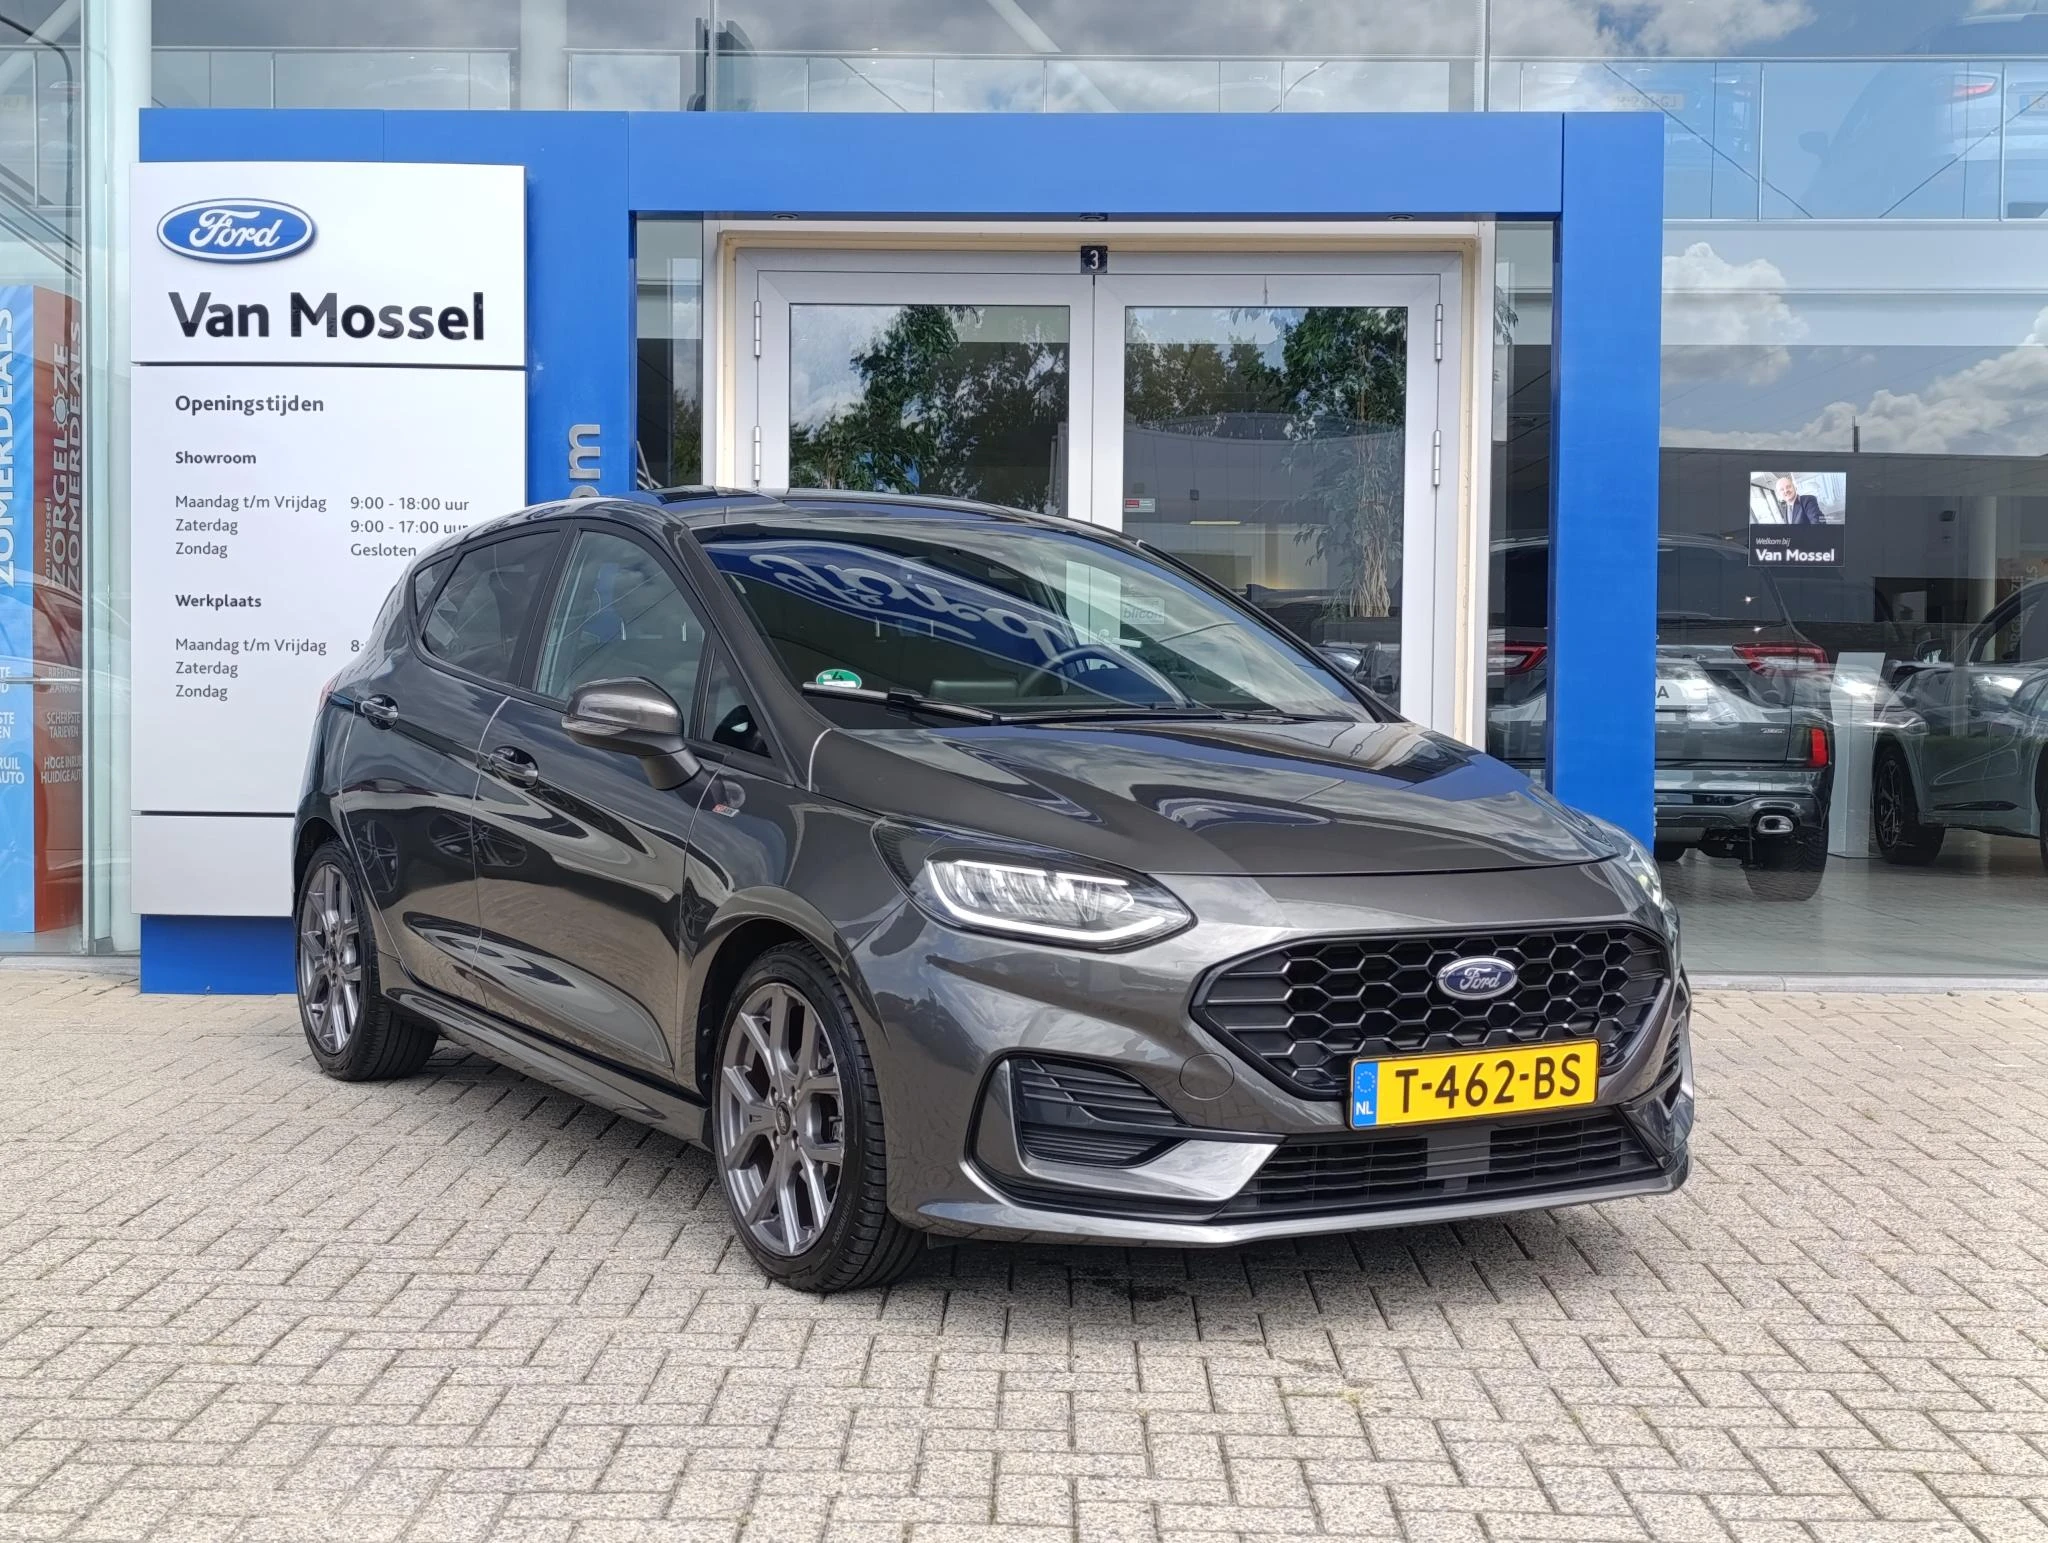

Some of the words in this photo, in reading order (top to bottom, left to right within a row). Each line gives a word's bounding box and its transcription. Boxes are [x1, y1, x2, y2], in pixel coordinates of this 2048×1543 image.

[189, 208, 282, 248] Ford
[1090, 250, 1099, 269] 3
[168, 292, 269, 338] Van
[290, 292, 484, 340] Mossel
[175, 395, 324, 416] Openingstijden
[67, 321, 80, 592] ZOMERDEALS
[175, 451, 257, 465] Showroom
[175, 495, 239, 512] Maandag
[243, 495, 270, 509] t/m
[274, 496, 327, 513] Vrijdag
[351, 497, 384, 510] 9:00
[399, 498, 440, 511] 18:00
[445, 501, 470, 511] uur
[175, 518, 239, 535] Zaterdag
[351, 520, 384, 533] 9:00
[399, 521, 439, 534] 17:00
[175, 542, 228, 559] Zondag
[351, 543, 417, 557] Gesloten
[1782, 538, 1791, 547] bij
[1756, 549, 1782, 561] Van
[1786, 549, 1835, 561] Mossel
[175, 594, 262, 611] Werkplaats
[175, 638, 239, 655] Maandag
[243, 638, 270, 652] t/m
[274, 639, 327, 656] Vrijdag
[175, 661, 239, 678] Zaterdag
[175, 684, 228, 701] Zondag
[44, 756, 64, 770] HOGE
[41, 770, 71, 784] HUIDIGE
[71, 769, 82, 782] AUT
[1460, 966, 1501, 991] Ford
[1395, 1053, 1581, 1113] T-462-BS
[1356, 1102, 1374, 1115] NL
